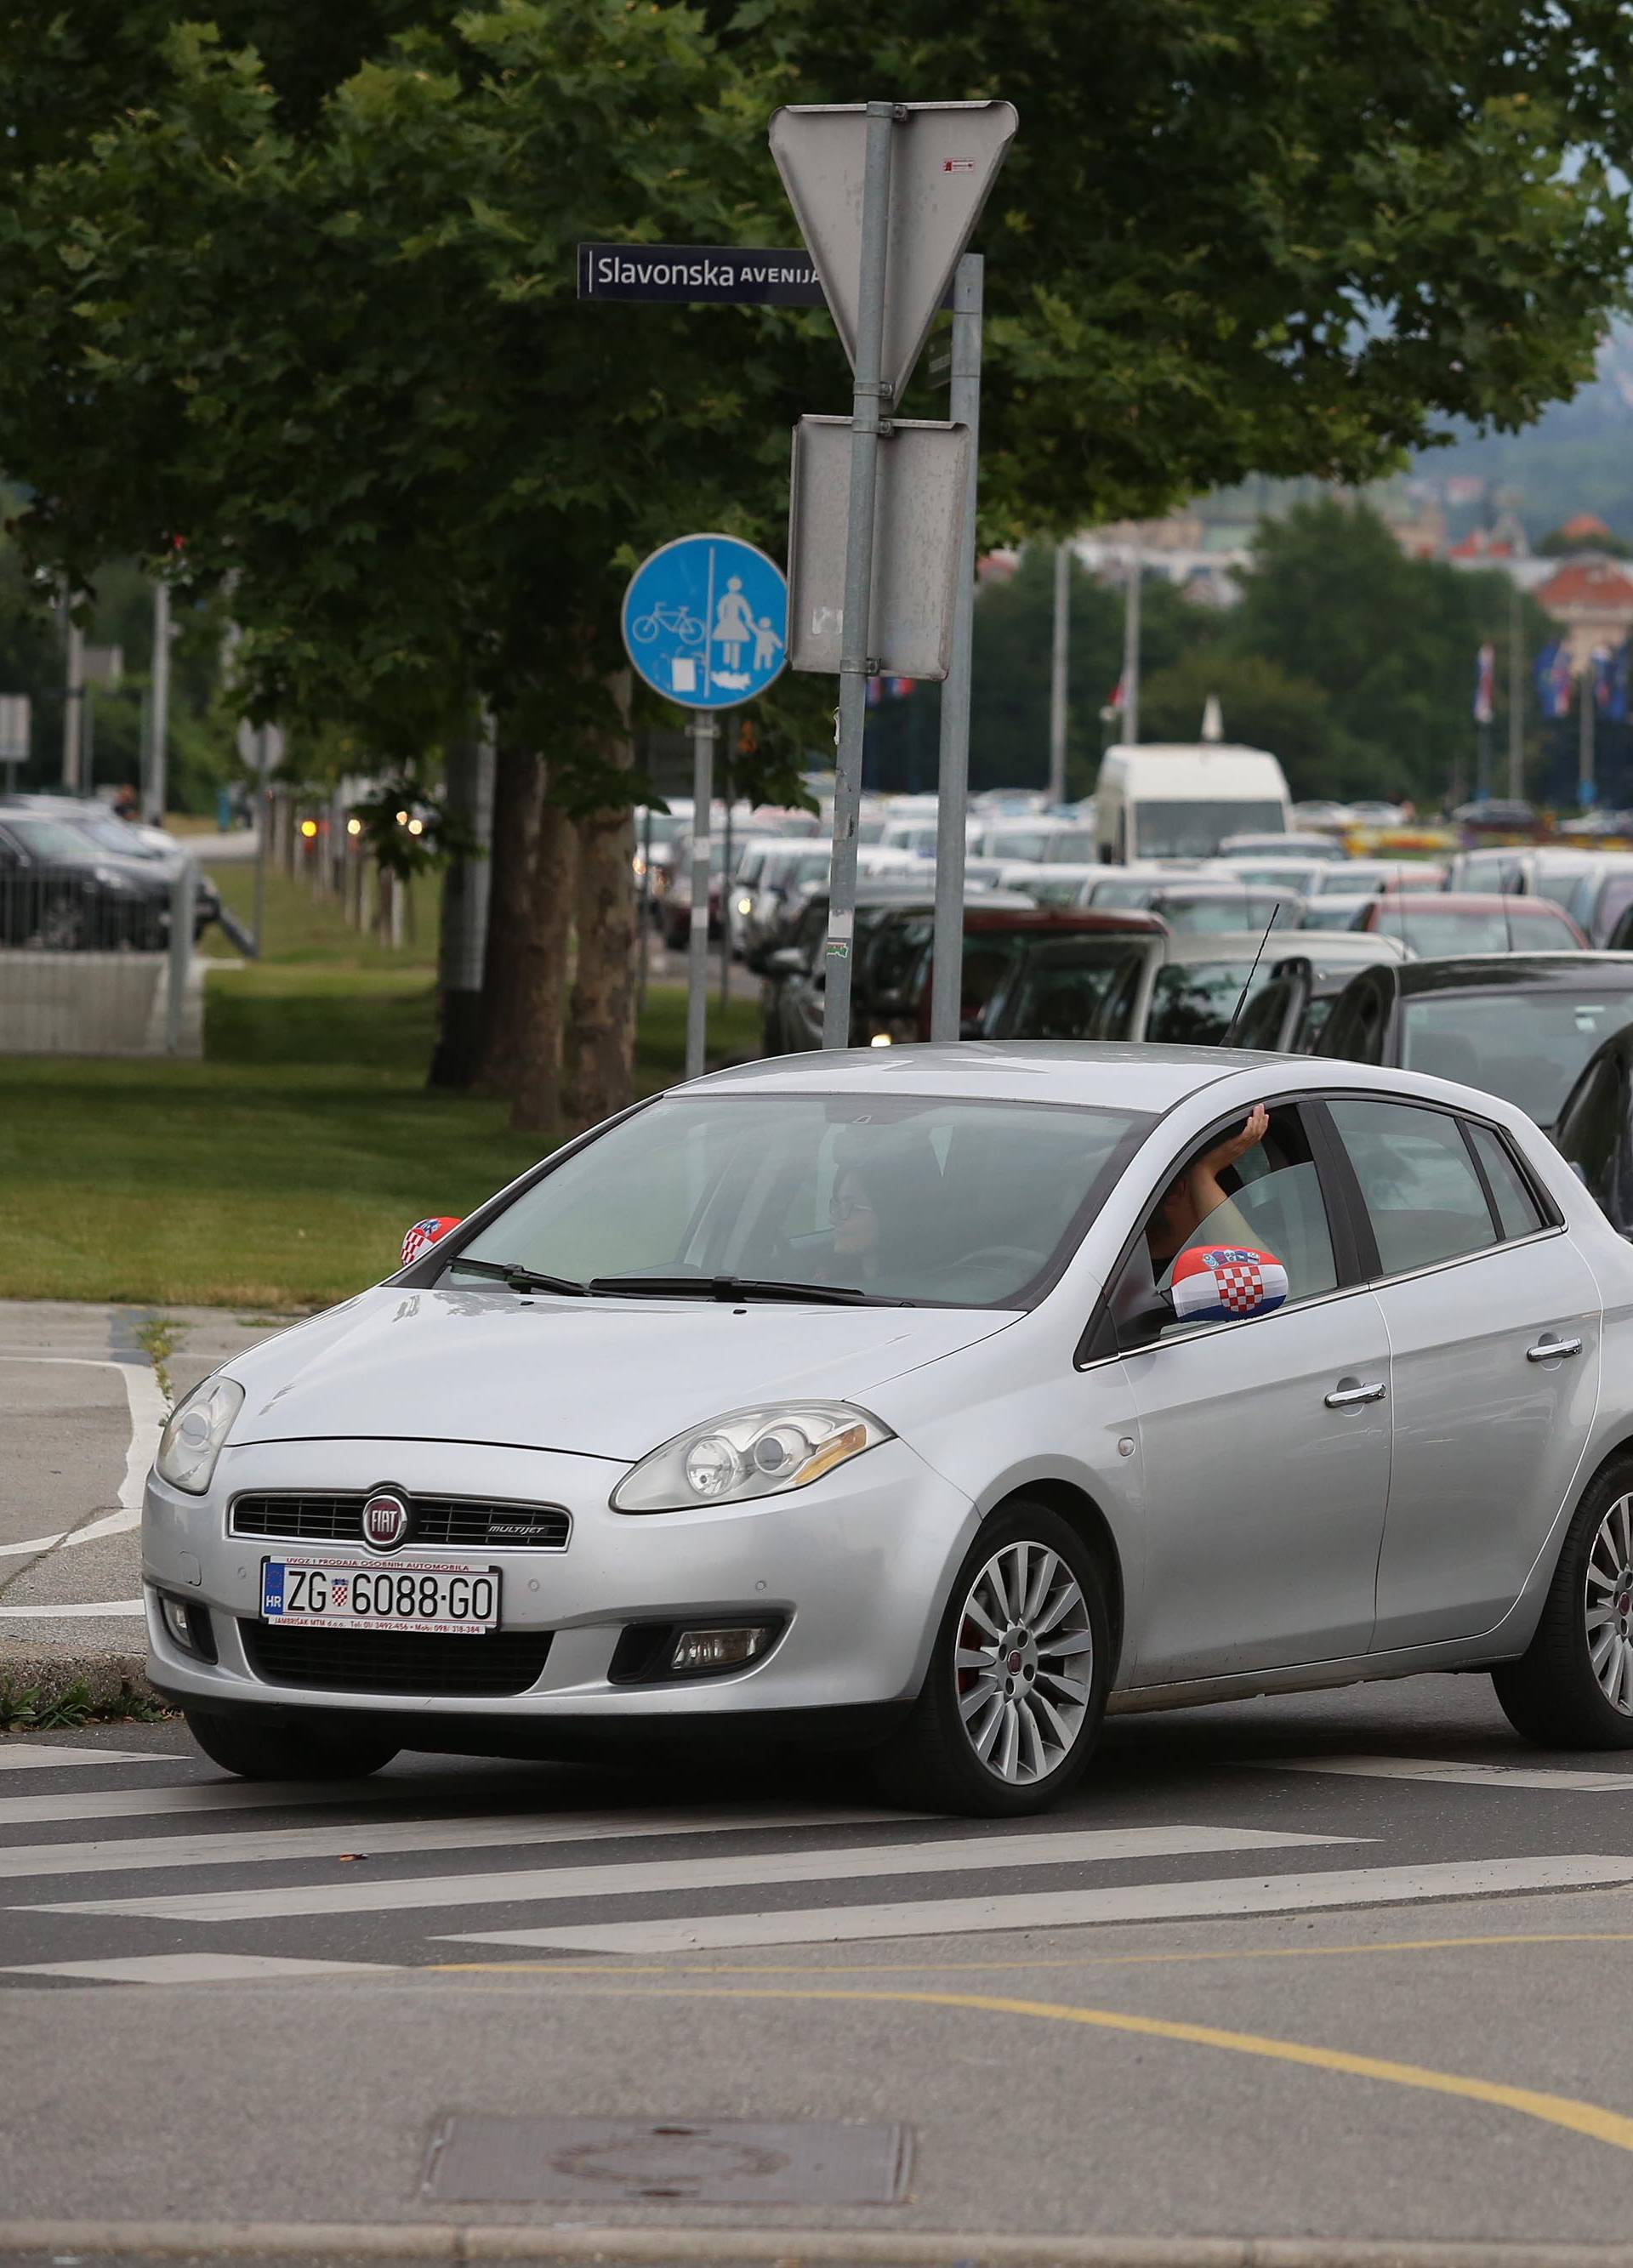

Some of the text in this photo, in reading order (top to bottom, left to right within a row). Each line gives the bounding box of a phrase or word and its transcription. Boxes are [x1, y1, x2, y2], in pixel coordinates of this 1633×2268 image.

[598, 256, 734, 287] Slavonska
[371, 1509, 398, 1532] FIAT
[488, 1525, 545, 1534] MULTIJET
[265, 1595, 282, 1608] HR
[287, 1571, 327, 1612] ZG
